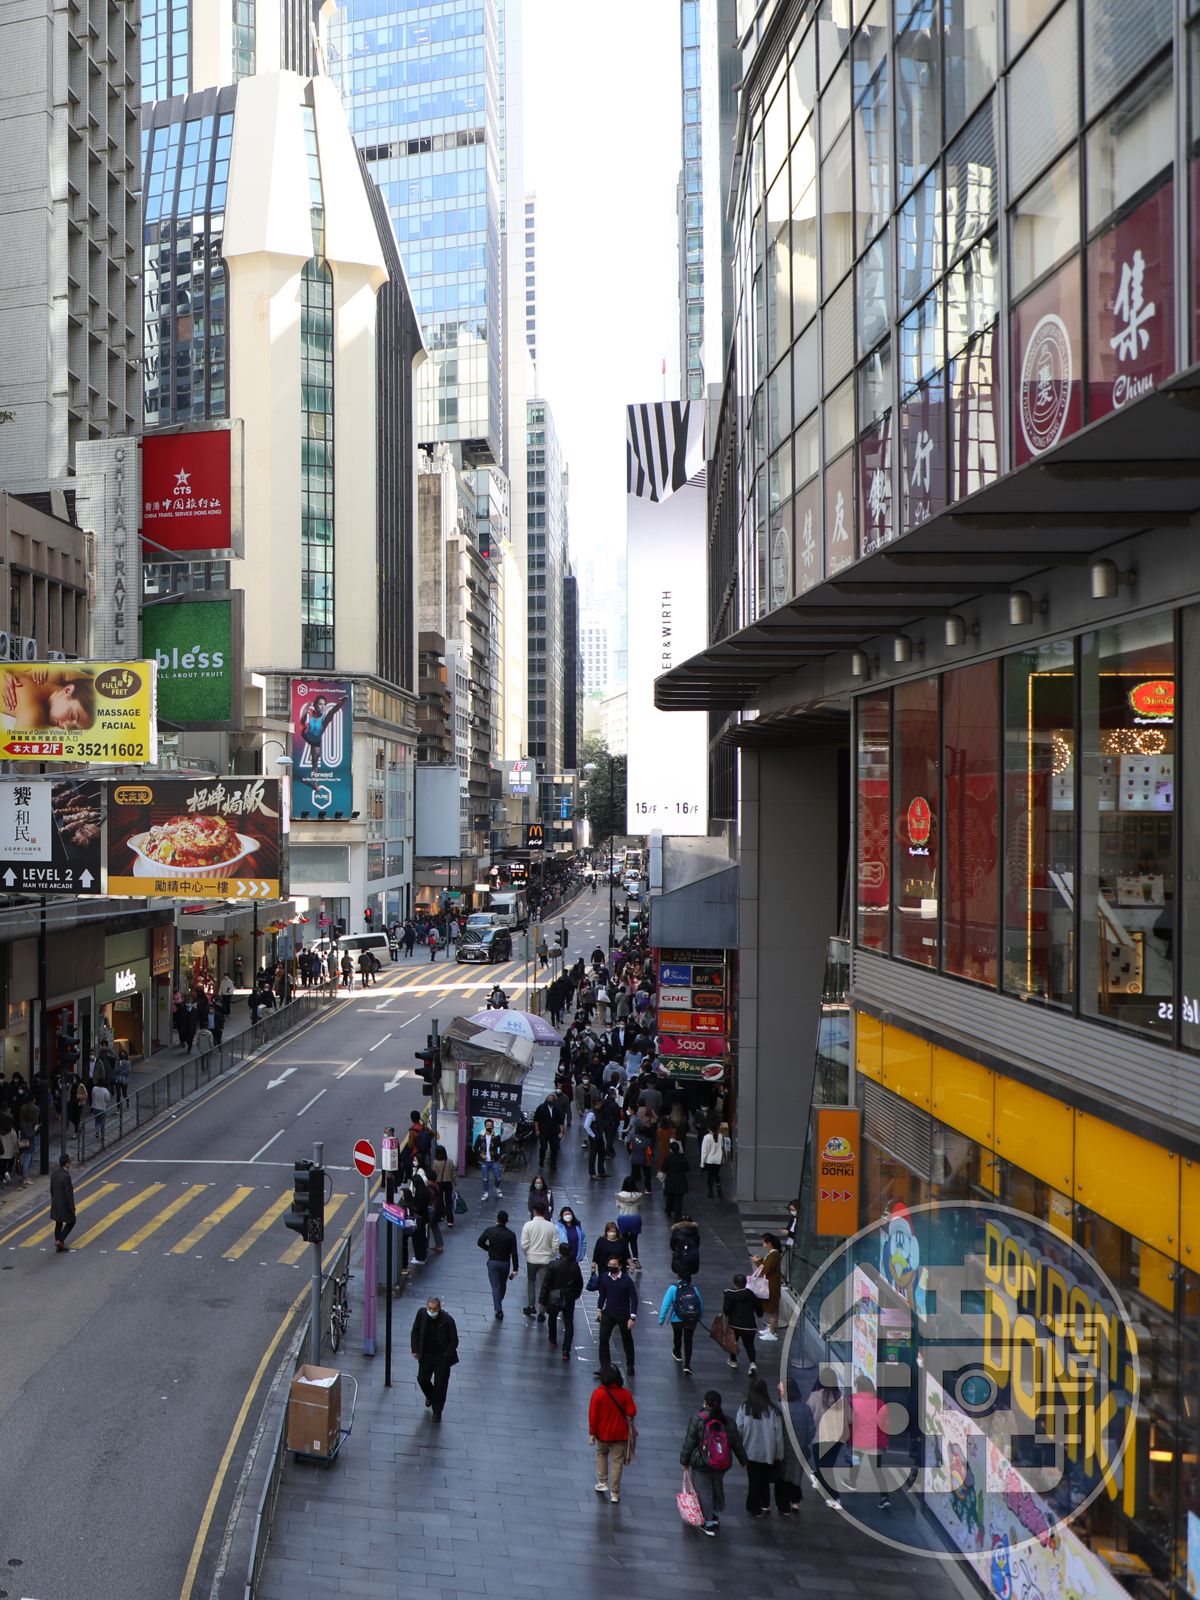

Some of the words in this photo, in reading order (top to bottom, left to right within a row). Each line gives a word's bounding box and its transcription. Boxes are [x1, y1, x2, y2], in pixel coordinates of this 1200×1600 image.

[1110, 249, 1156, 362] 集
[114, 447, 127, 531] CHINA
[173, 486, 192, 495] CTS
[114, 541, 127, 646] TRAVEL
[662, 590, 672, 635] WIRTH
[155, 646, 224, 670] bless
[97, 709, 141, 717] MASSAGE
[42, 744, 60, 754] 2/F
[77, 743, 144, 757] 35211602
[635, 802, 657, 815] 15/F
[676, 802, 699, 815] 16/F
[22, 868, 60, 881] LEVEL
[65, 869, 73, 881] 2
[822, 1168, 854, 1177] DONKI
